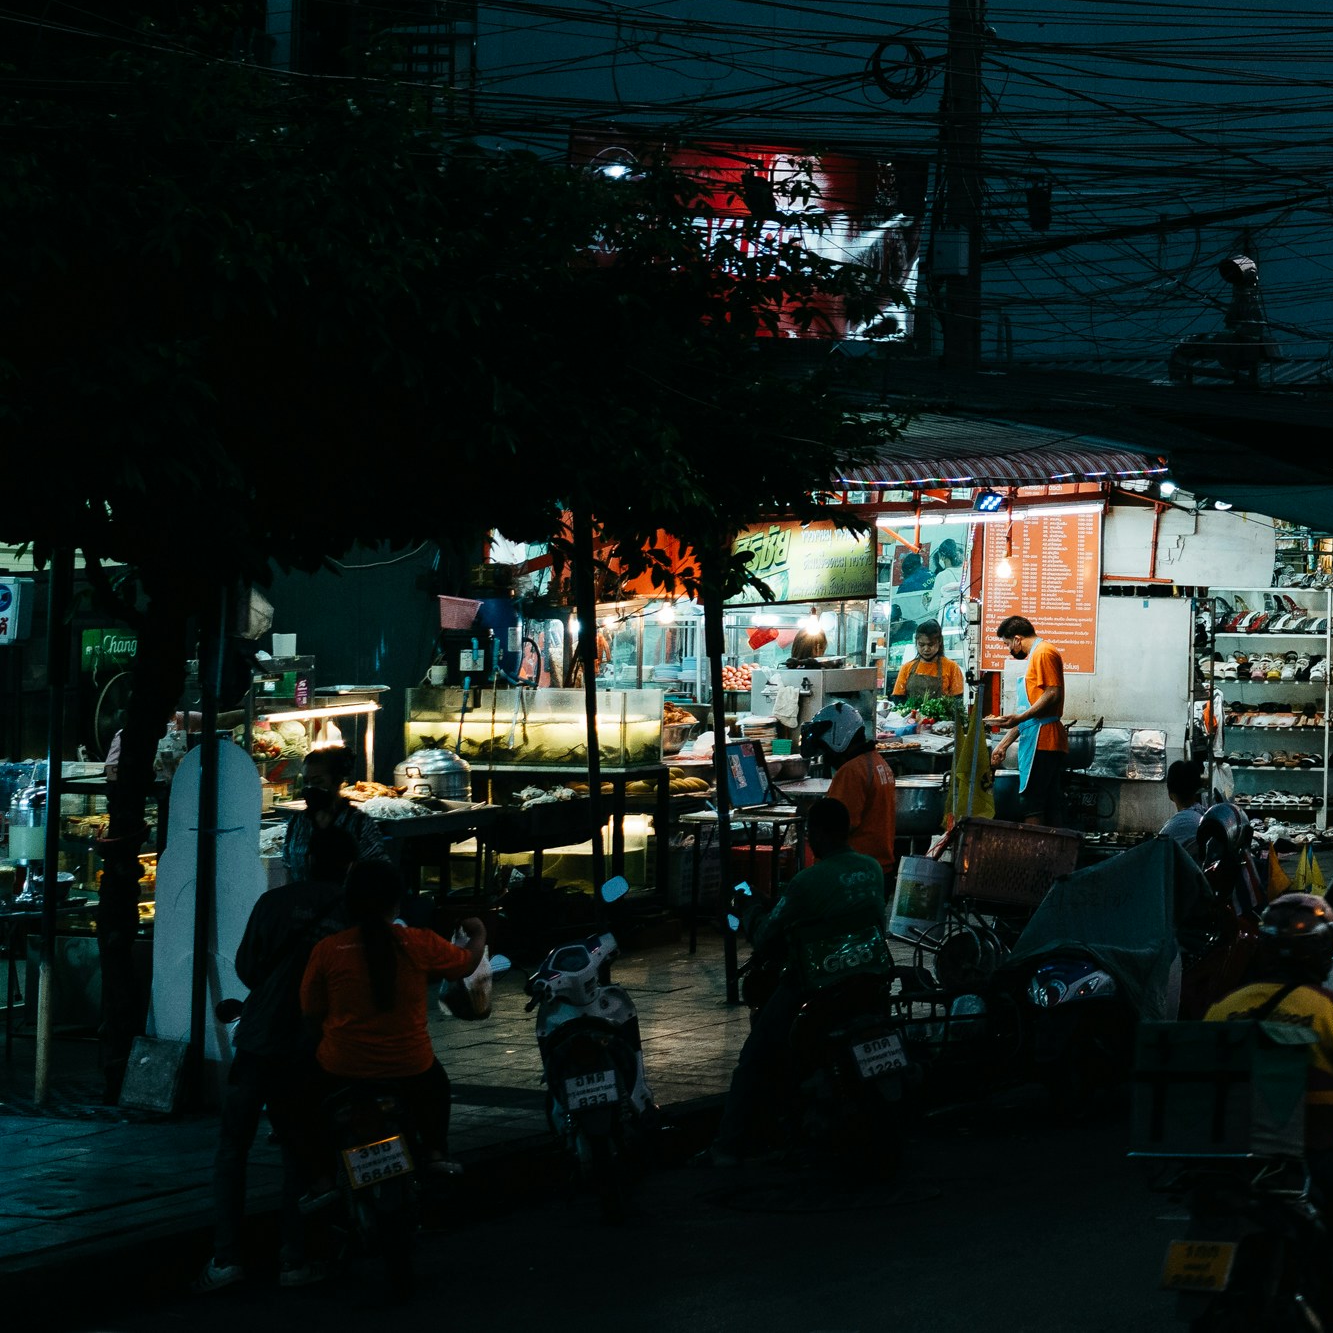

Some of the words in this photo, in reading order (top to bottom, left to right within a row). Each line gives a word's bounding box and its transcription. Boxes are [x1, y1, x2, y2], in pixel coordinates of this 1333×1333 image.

[103, 635, 138, 657] Chang
[822, 948, 874, 973] Grab
[868, 1058, 902, 1075] 1226
[579, 1093, 608, 1107] 833
[361, 1161, 403, 1182] 6845
